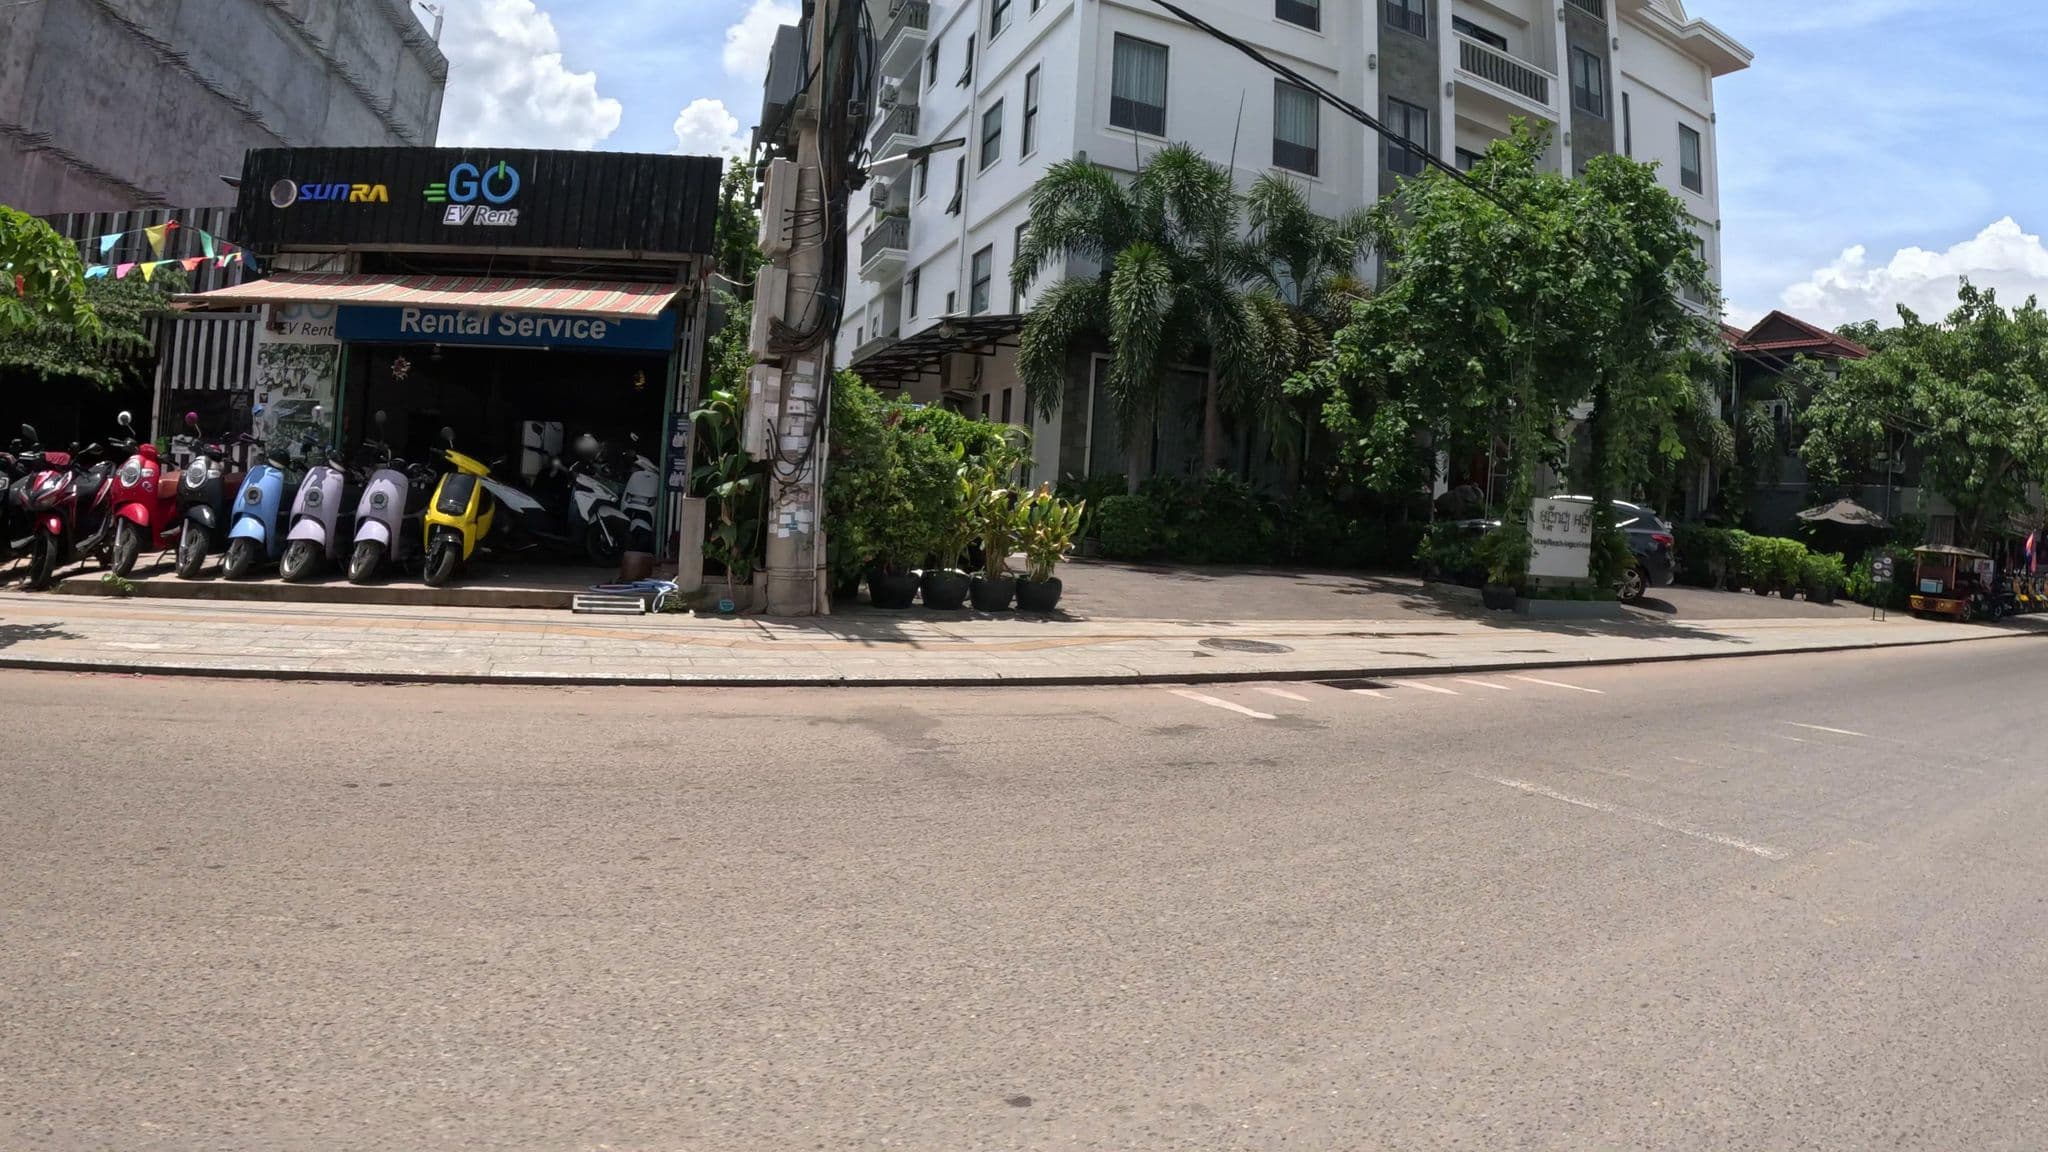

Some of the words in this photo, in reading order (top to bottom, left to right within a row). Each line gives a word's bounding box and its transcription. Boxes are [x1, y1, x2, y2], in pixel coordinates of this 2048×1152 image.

[299, 183, 390, 203] SUNRA
[445, 205, 474, 225] EV
[474, 209, 518, 226] Rent
[278, 321, 299, 335] EV
[301, 322, 334, 336] Rent
[400, 307, 490, 335] Rental
[498, 312, 607, 339] Service
